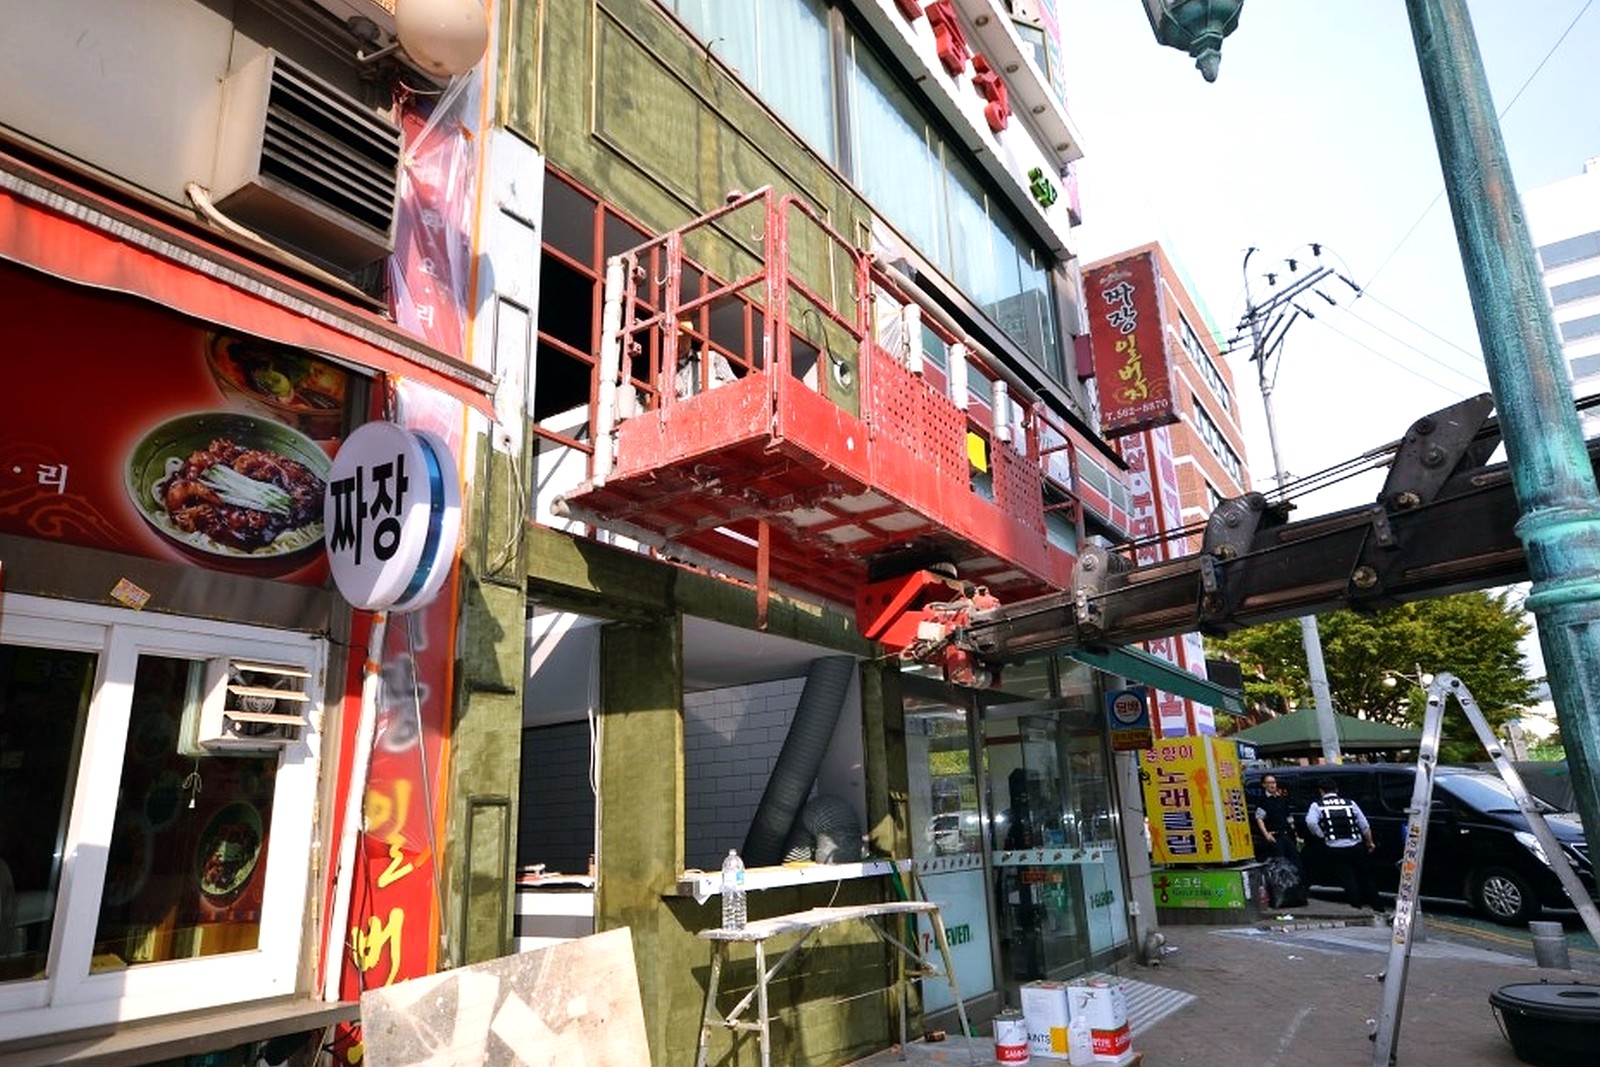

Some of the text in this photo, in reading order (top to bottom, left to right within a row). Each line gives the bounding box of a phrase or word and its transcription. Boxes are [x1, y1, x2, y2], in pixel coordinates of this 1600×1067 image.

[1102, 283, 1137, 334] 짜장
[1115, 335, 1149, 401] 일번지
[330, 453, 408, 565] 짜장
[1202, 829, 1214, 854] 3F
